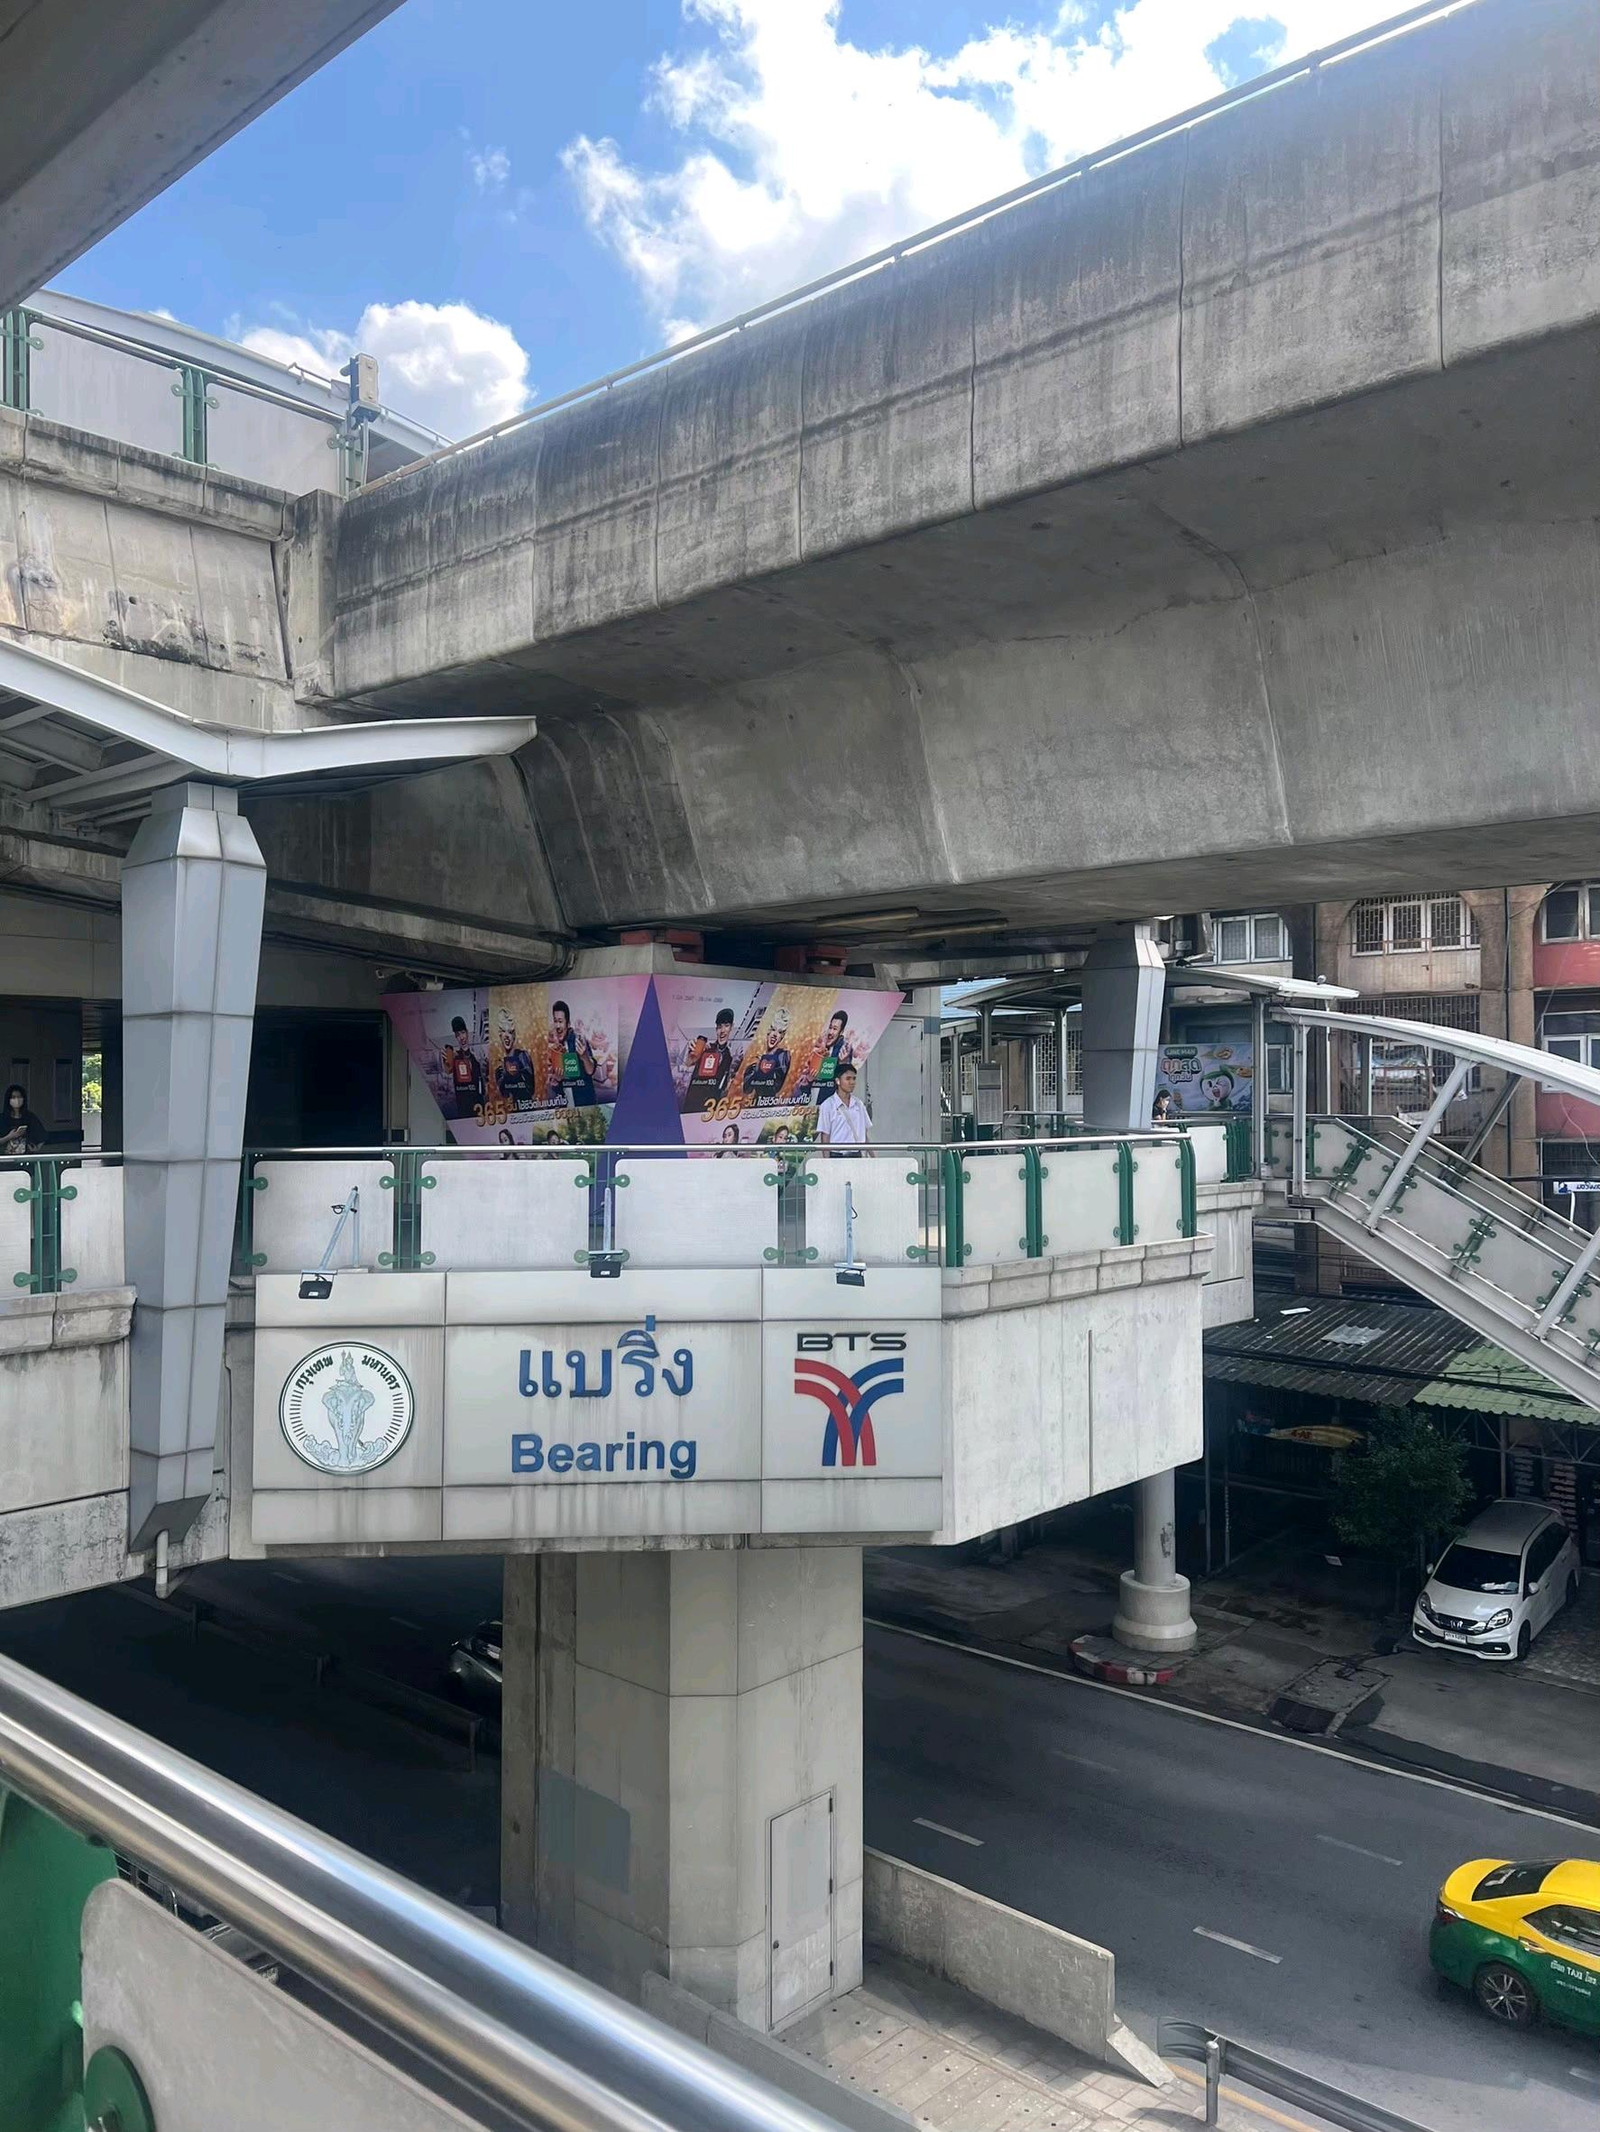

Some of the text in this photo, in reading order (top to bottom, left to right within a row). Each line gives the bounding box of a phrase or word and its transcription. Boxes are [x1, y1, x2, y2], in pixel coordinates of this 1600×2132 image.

[474, 1103, 507, 1127] 365
[702, 1098, 743, 1122] 365
[519, 1315, 693, 1398] แบริ่ง
[797, 1332, 907, 1352] BTS
[295, 1355, 401, 1390] กรุงเทพ มหานคร
[512, 1432, 697, 1479] Bearing
